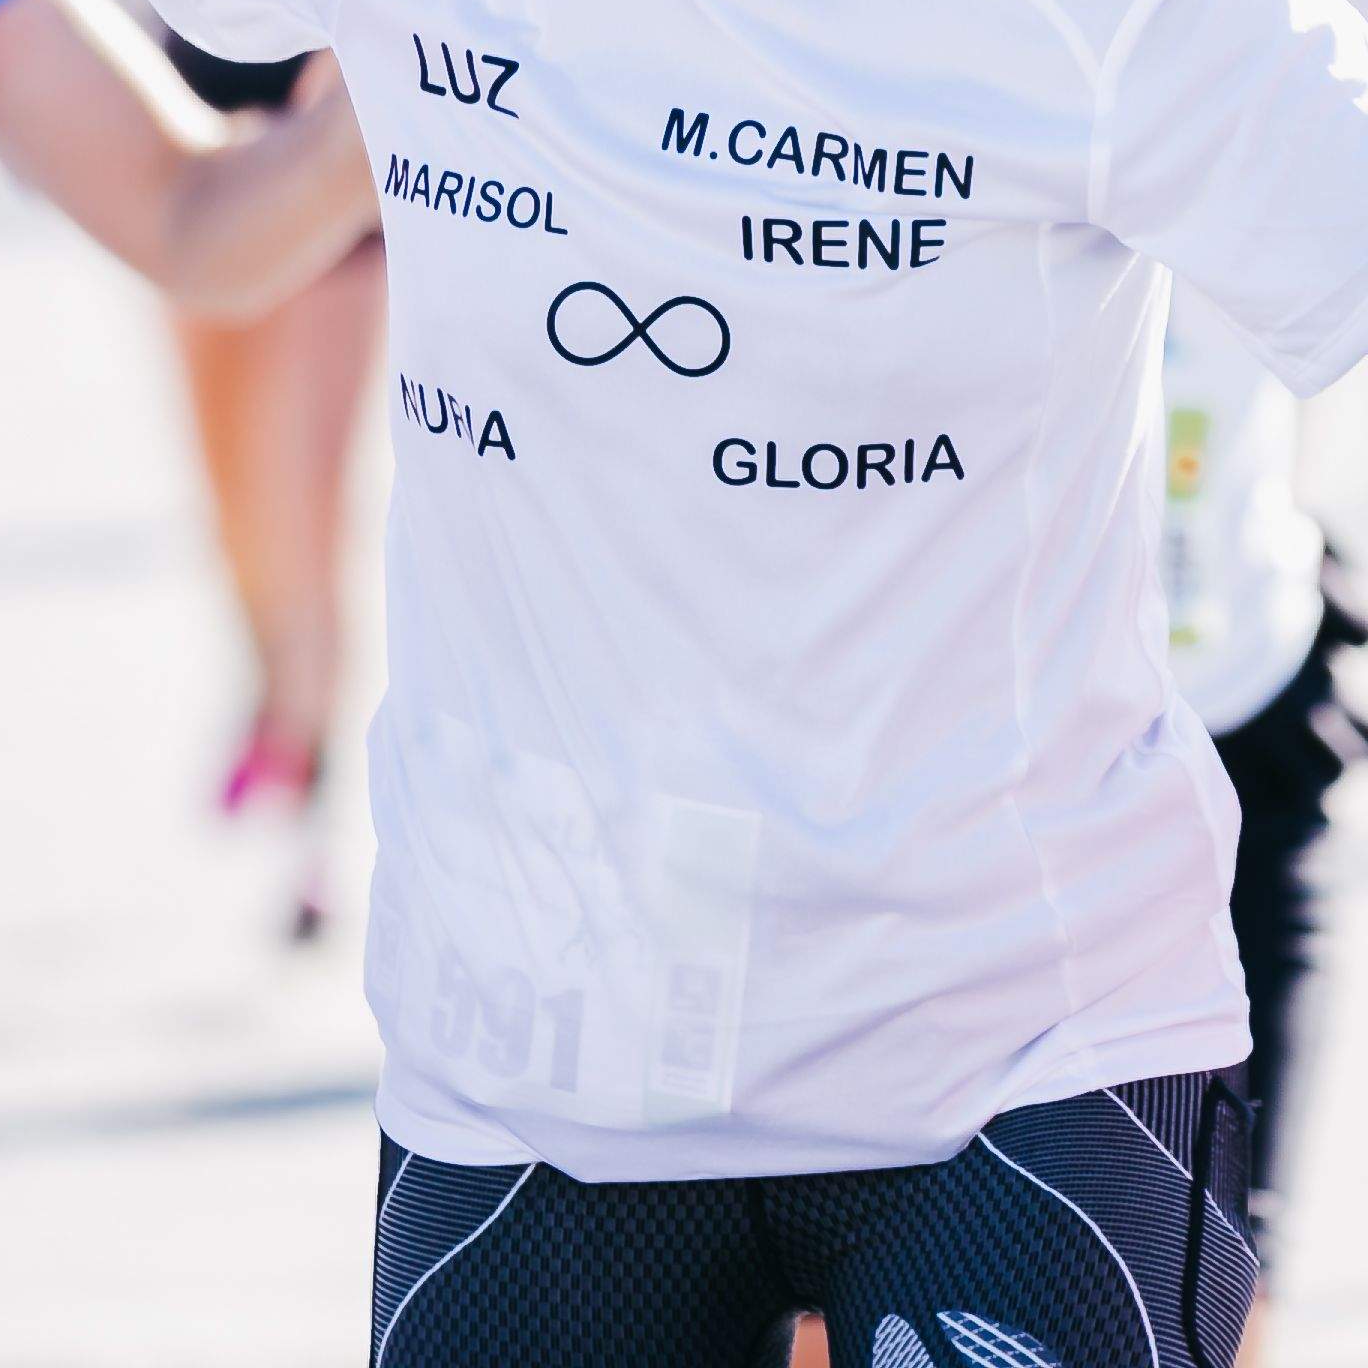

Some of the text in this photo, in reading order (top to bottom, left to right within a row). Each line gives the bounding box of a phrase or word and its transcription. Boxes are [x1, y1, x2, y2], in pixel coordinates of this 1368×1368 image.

[412, 33, 520, 119] LUZ
[385, 153, 569, 236] MARISOL
[661, 107, 974, 200] M.CARMEN
[741, 215, 947, 271] IRENE
[400, 372, 516, 461] NURIA
[712, 433, 965, 490] GLORIA
